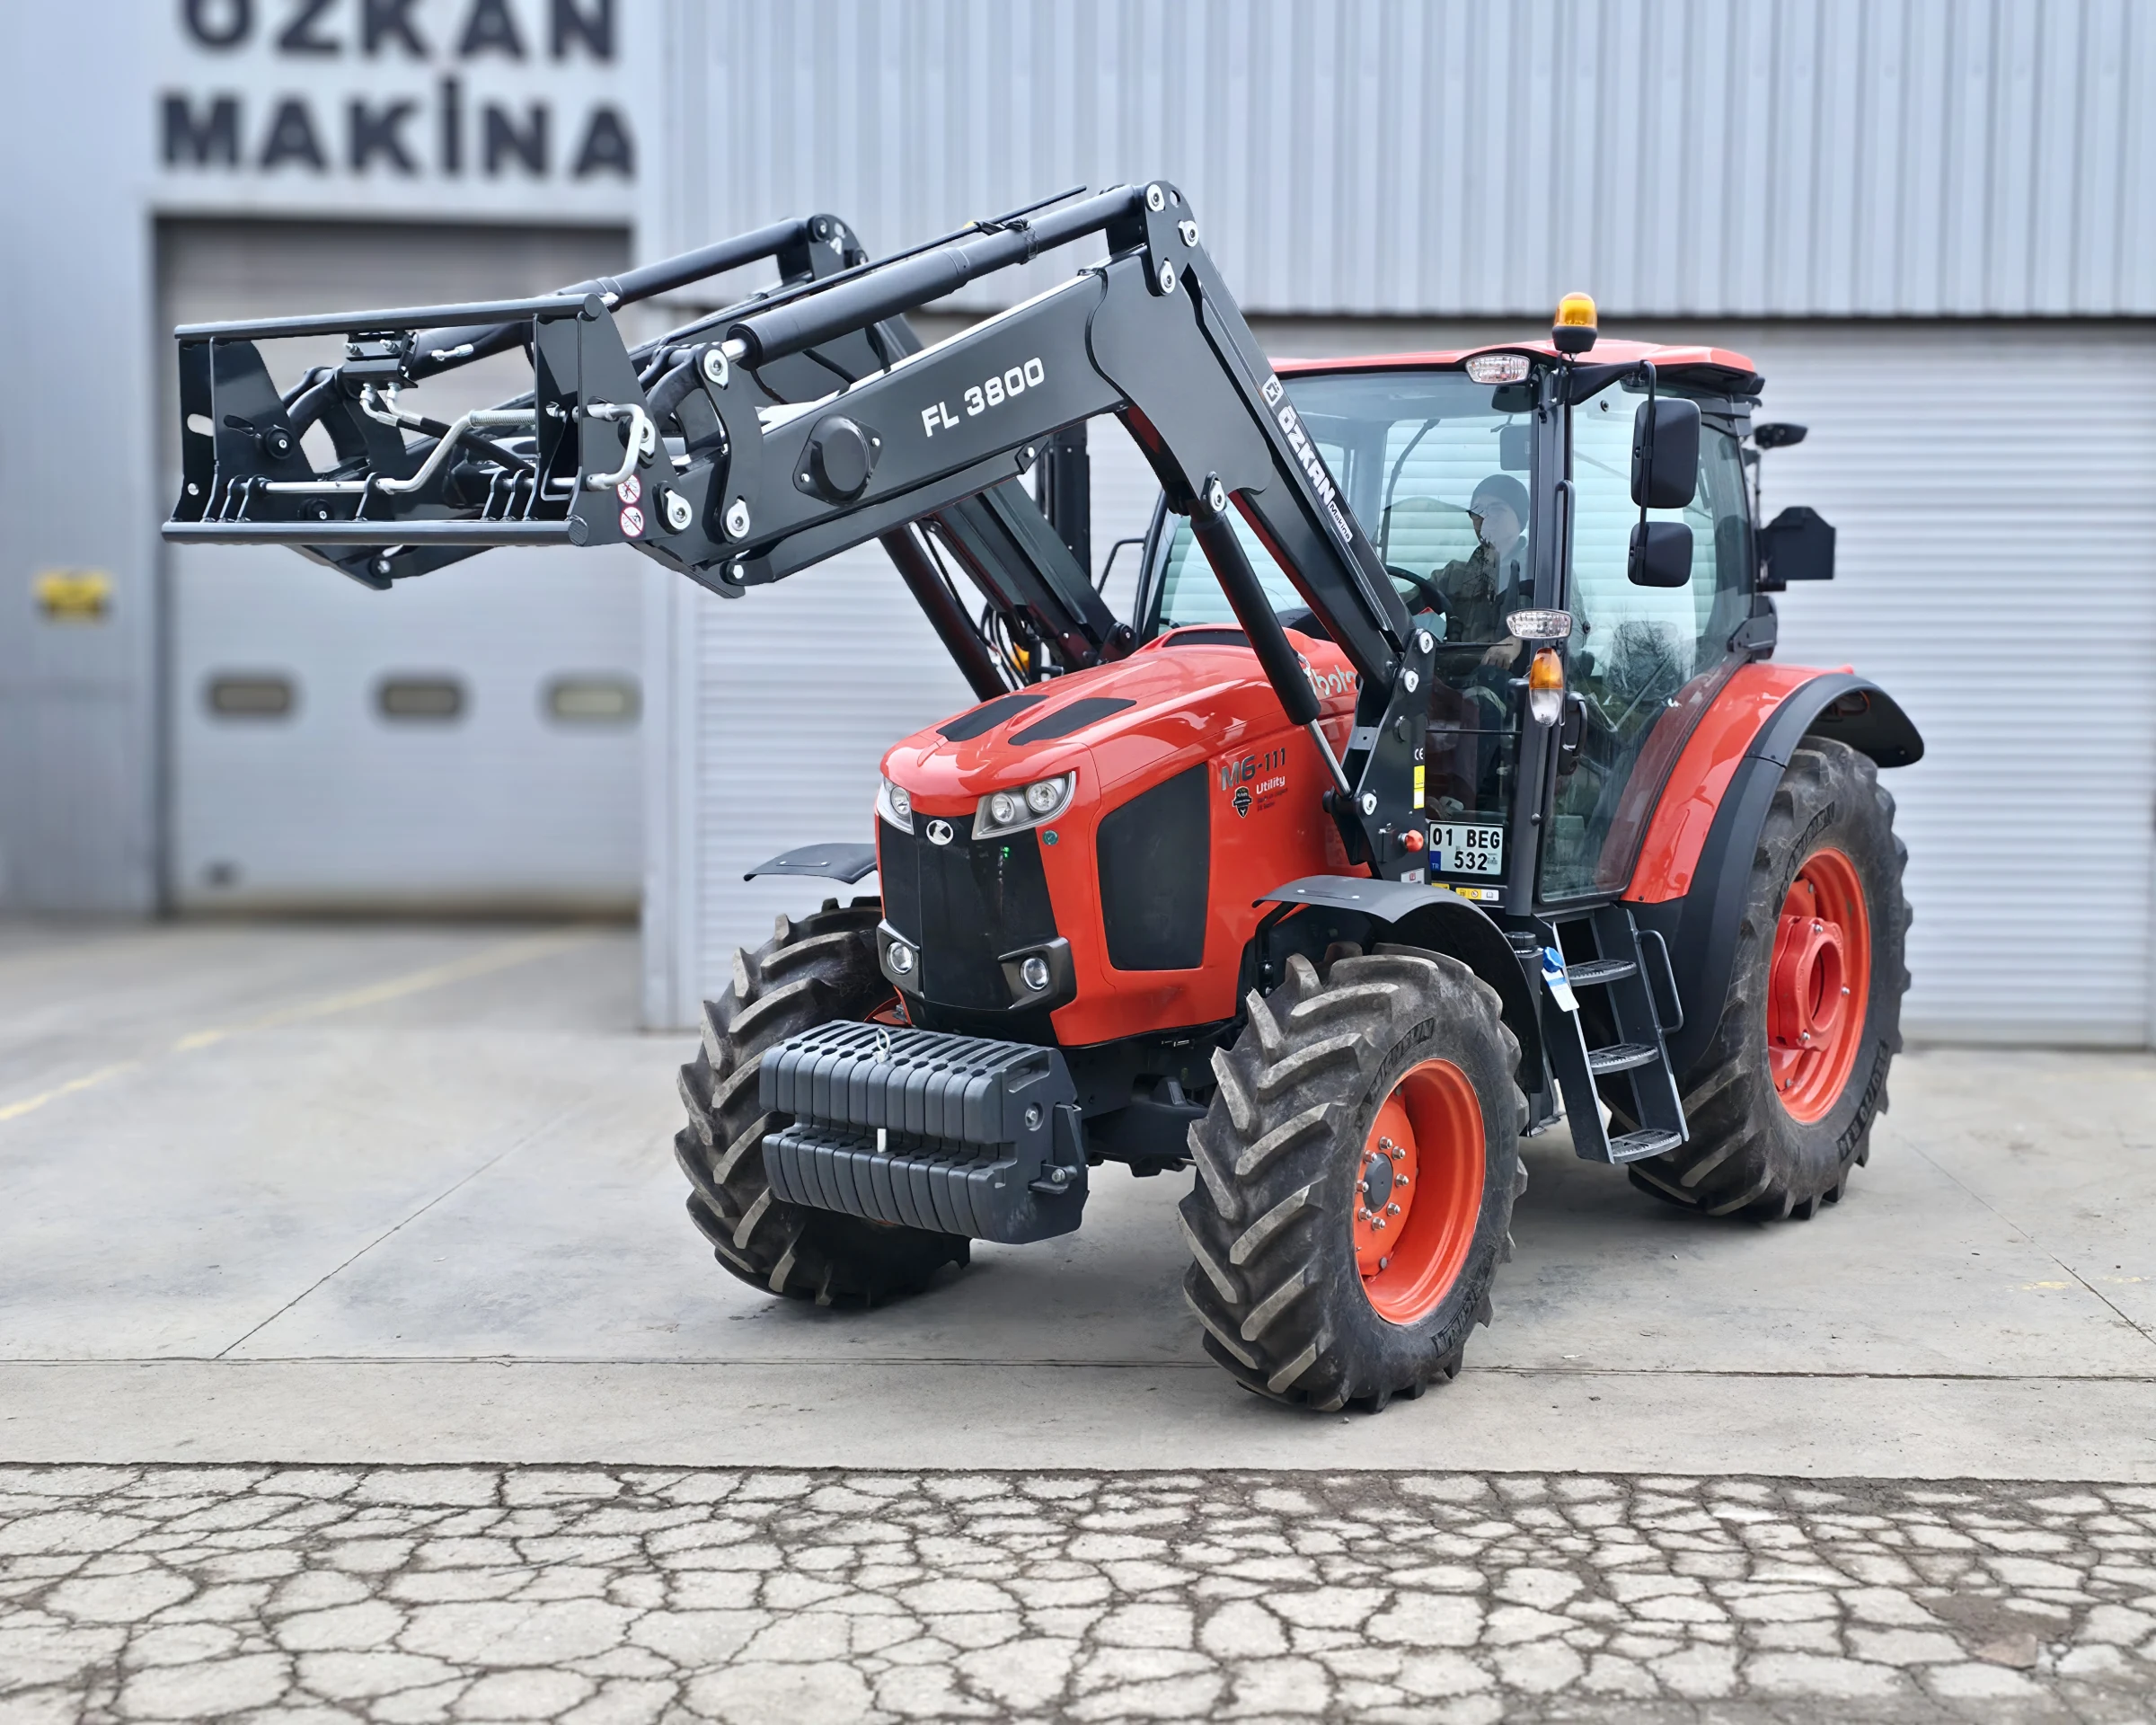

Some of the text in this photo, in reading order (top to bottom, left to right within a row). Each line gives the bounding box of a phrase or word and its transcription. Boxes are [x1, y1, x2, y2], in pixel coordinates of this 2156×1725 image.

[159, 74, 637, 183] MAKİNA
[922, 357, 1045, 438] FL 3800
[1277, 405, 1349, 539] ÖZKAN Makina
[1303, 664, 1356, 696] bota
[1222, 748, 1286, 791] M6-111
[1256, 776, 1286, 794] Utility
[1433, 827, 1500, 849] 01 BEG
[1454, 851, 1488, 871] 532
